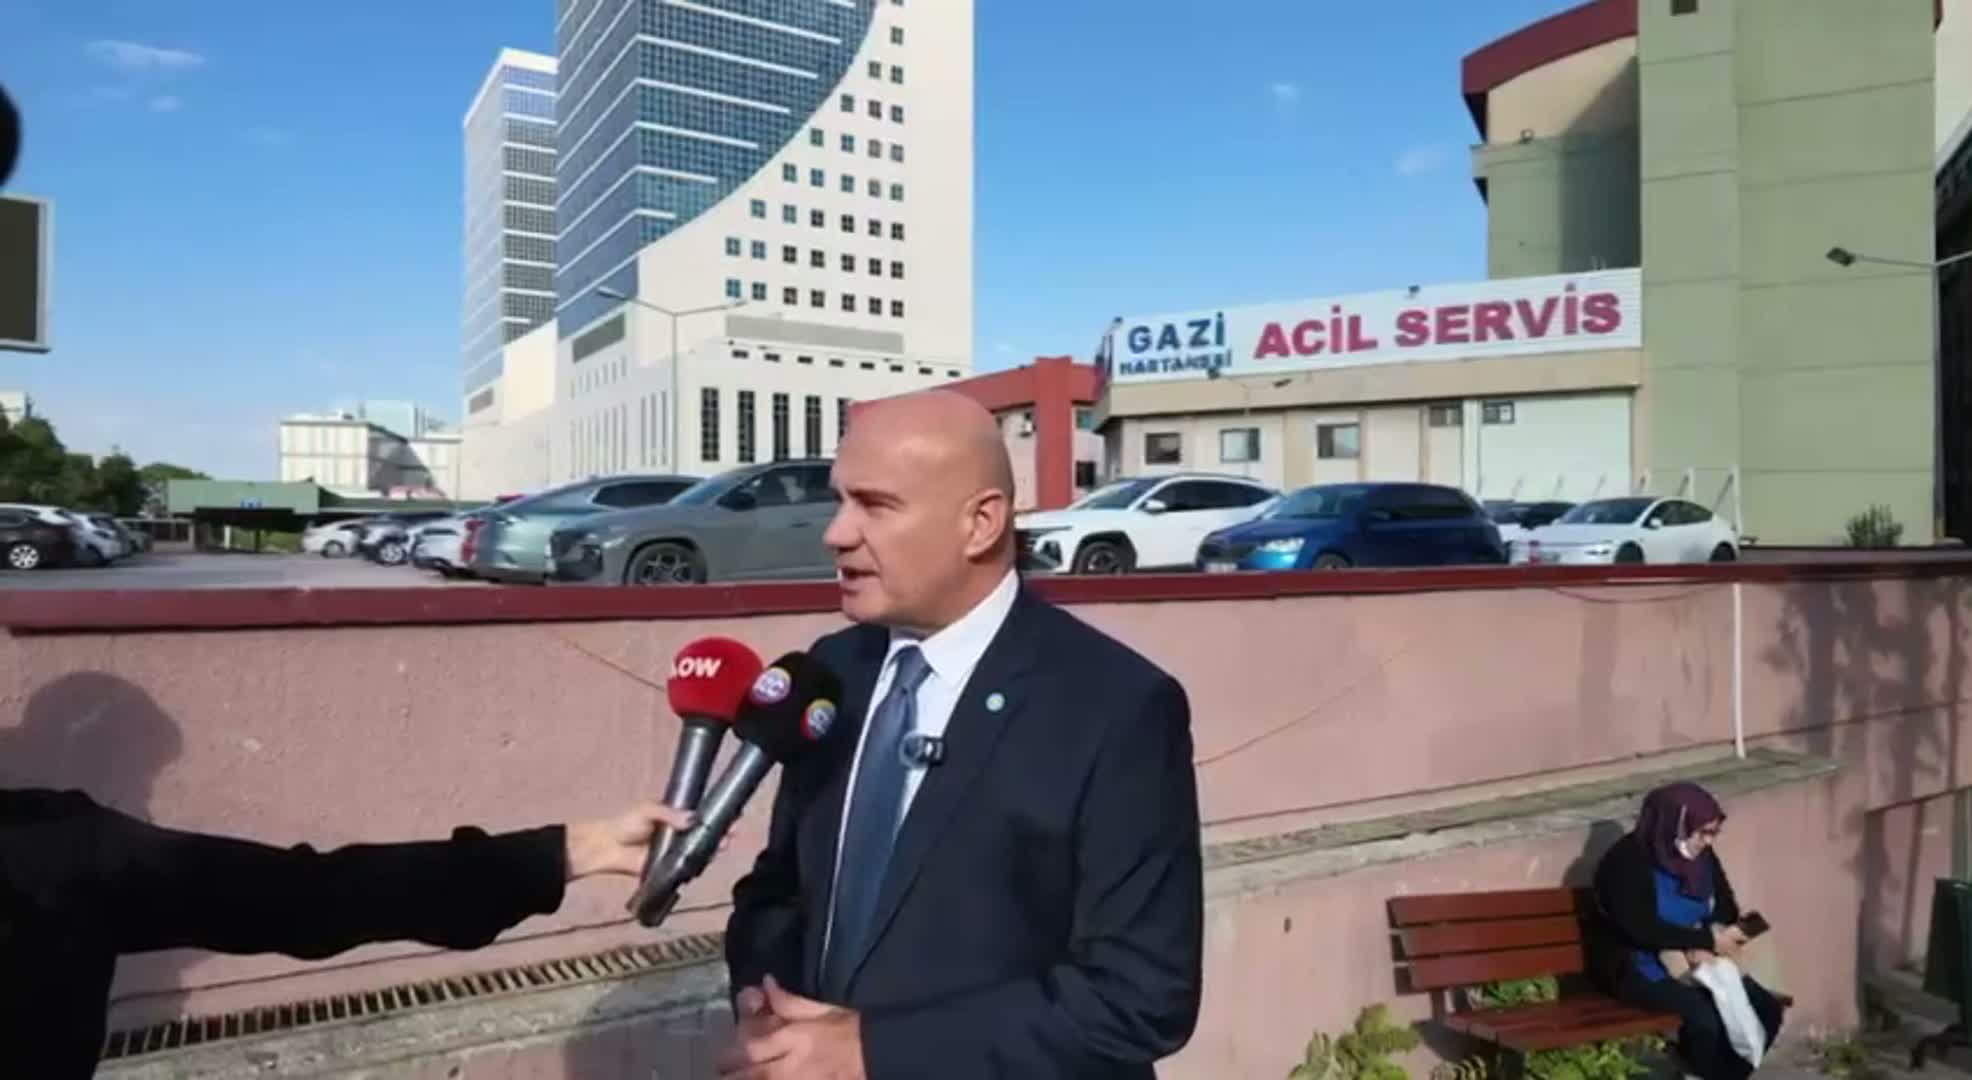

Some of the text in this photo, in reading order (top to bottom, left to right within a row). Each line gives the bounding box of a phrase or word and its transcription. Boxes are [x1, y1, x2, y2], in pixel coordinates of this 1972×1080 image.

[1128, 311, 1225, 354] GAZİ
[1253, 283, 1621, 359] ACİL SERVİS
